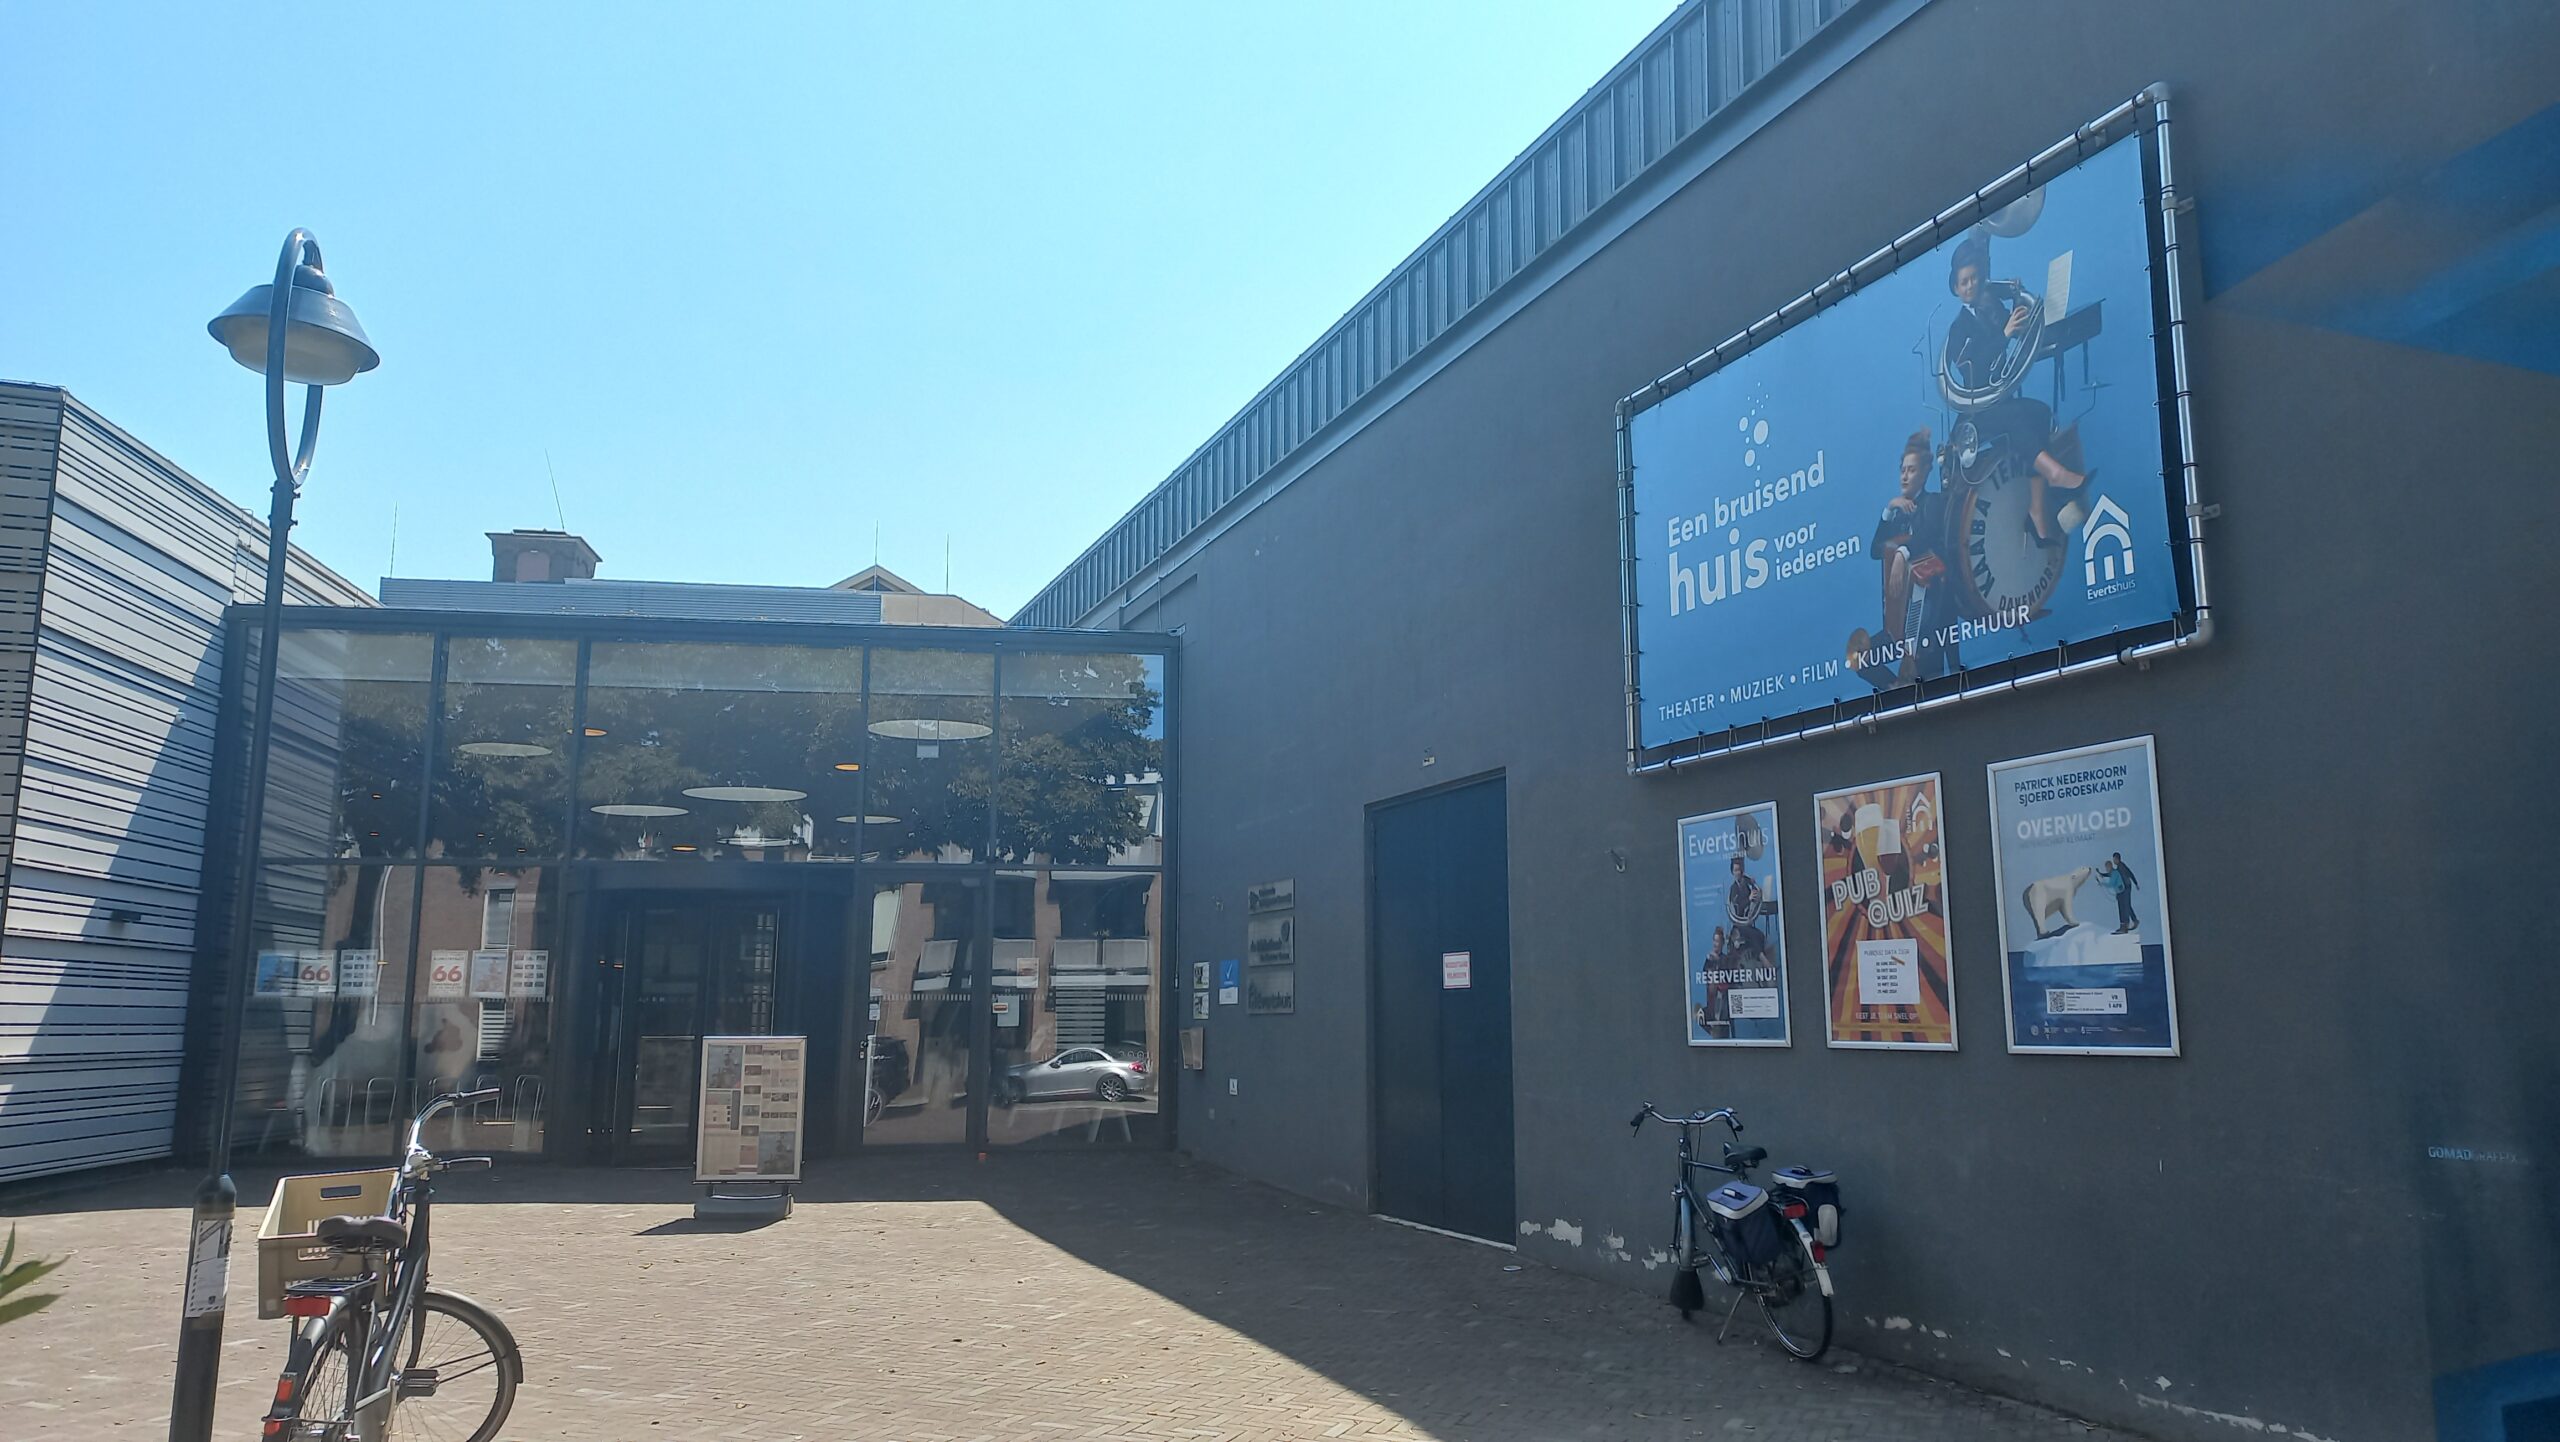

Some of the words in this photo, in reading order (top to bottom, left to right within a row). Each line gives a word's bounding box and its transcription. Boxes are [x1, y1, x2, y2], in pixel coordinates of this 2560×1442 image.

[1668, 516, 1708, 548] Een
[1714, 450, 1825, 528] bruisend
[1773, 522, 1817, 553] voor
[1668, 527, 1769, 617] huis
[1775, 535, 1860, 581] iedereen
[2087, 578, 2136, 600] Evertshuis
[1658, 692, 1716, 721] THEATER
[1729, 676, 1785, 705] MUZIEK
[1801, 659, 1839, 685] FILM
[1857, 636, 1916, 670] KUNST
[1934, 604, 2032, 648] VERHUUR
[2014, 776, 2054, 793] PATRICK
[2056, 764, 2127, 787] NEDERKOORN
[2019, 789, 2055, 807] SJOERD
[2057, 778, 2124, 799] GROESKAMP
[1688, 823, 1769, 857] Evertshuis
[2016, 806, 2132, 840] OVERVLOED
[1831, 867, 1881, 911] PUB
[1867, 883, 1929, 928] QUIZ
[301, 965, 331, 982] 66
[431, 965, 463, 983] 66
[1695, 969, 1753, 985] RESERVEER
[1755, 967, 1776, 982] NU!
